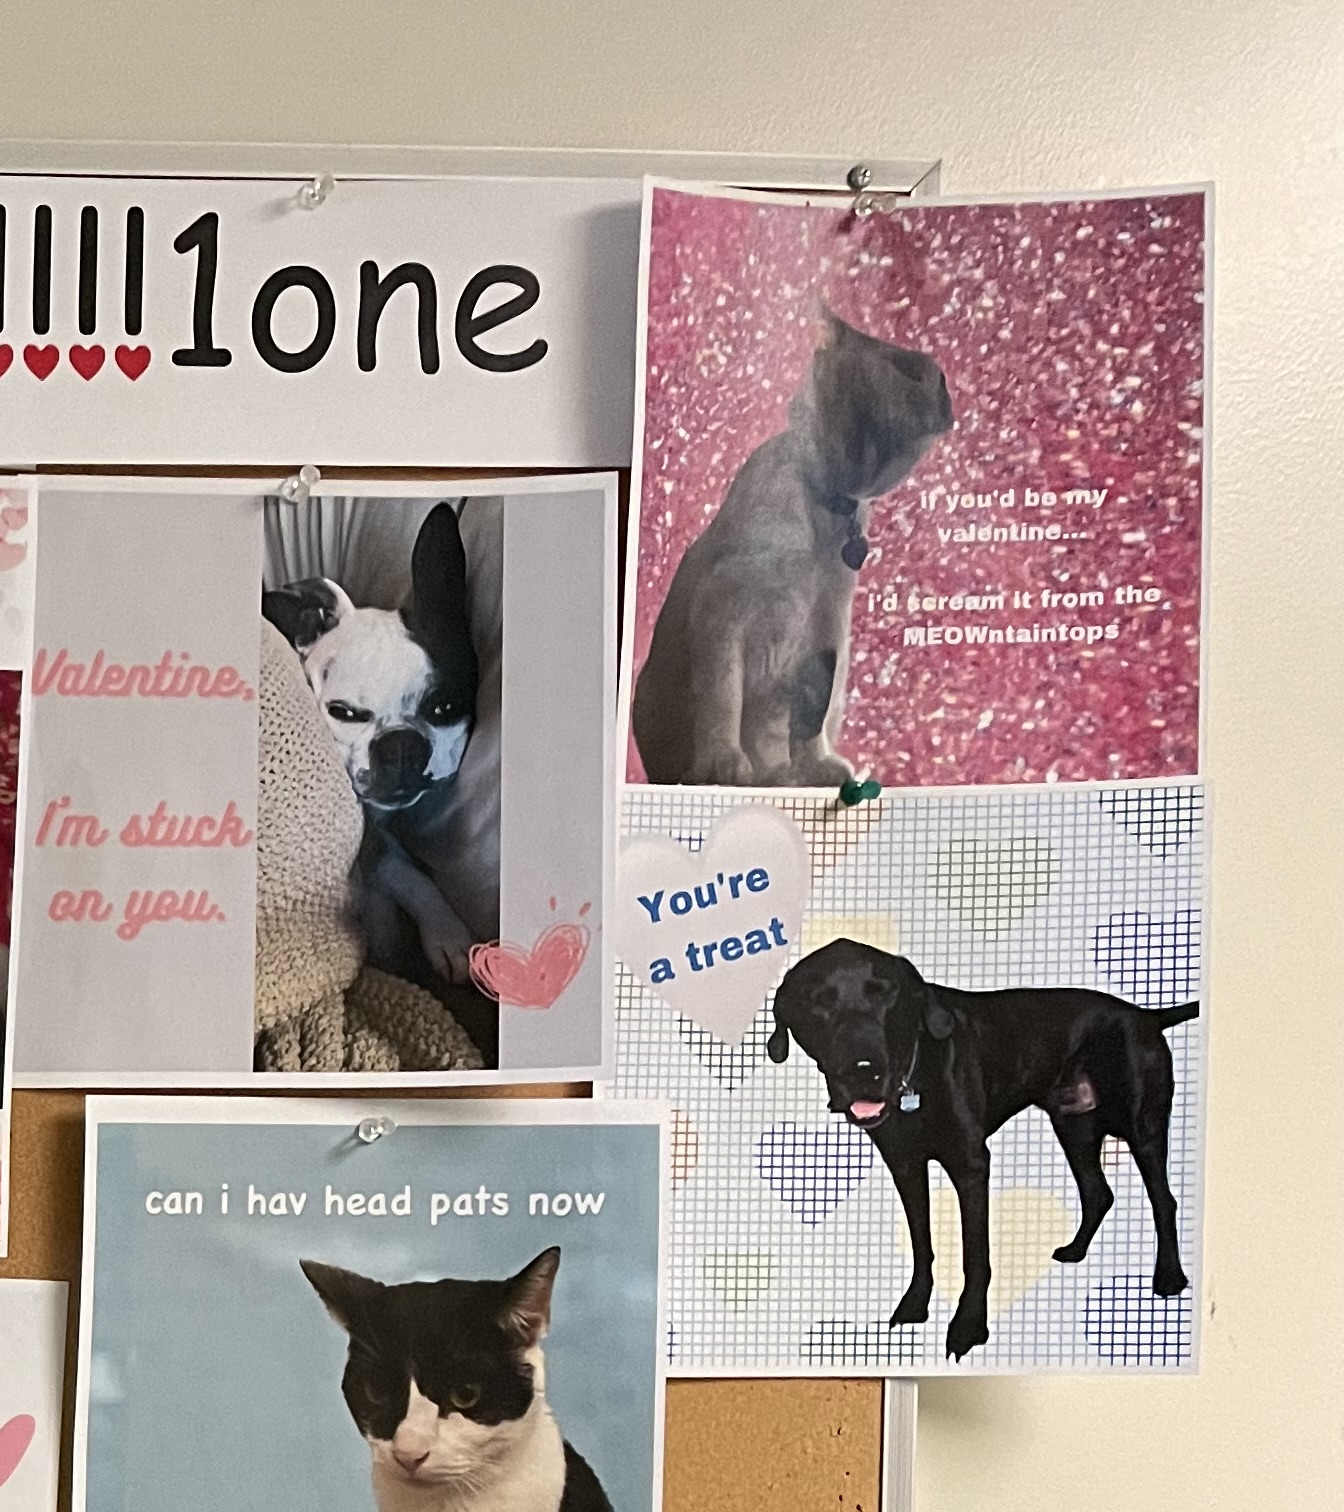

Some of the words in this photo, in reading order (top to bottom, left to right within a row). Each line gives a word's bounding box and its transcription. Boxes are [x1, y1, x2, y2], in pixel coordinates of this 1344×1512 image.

[947, 488, 1014, 513] you'd
[1024, 487, 1057, 507] be
[1066, 488, 1108, 508] my
[868, 593, 898, 612] i'd
[907, 595, 1004, 613] scream
[1013, 591, 1032, 609] it
[1040, 589, 1104, 609] from
[1115, 586, 1162, 604] the
[903, 623, 1120, 647] MEOWntaintops
[35, 795, 109, 847] I'm
[120, 800, 253, 847] stuck
[48, 889, 113, 922] on
[637, 868, 770, 924] You're
[649, 957, 676, 984] a
[686, 917, 787, 972] treat
[144, 1191, 203, 1215] can
[221, 1183, 229, 1214] i
[247, 1184, 307, 1216] hav
[324, 1185, 412, 1216] head
[430, 1185, 509, 1226] pats
[529, 1192, 605, 1216] now
